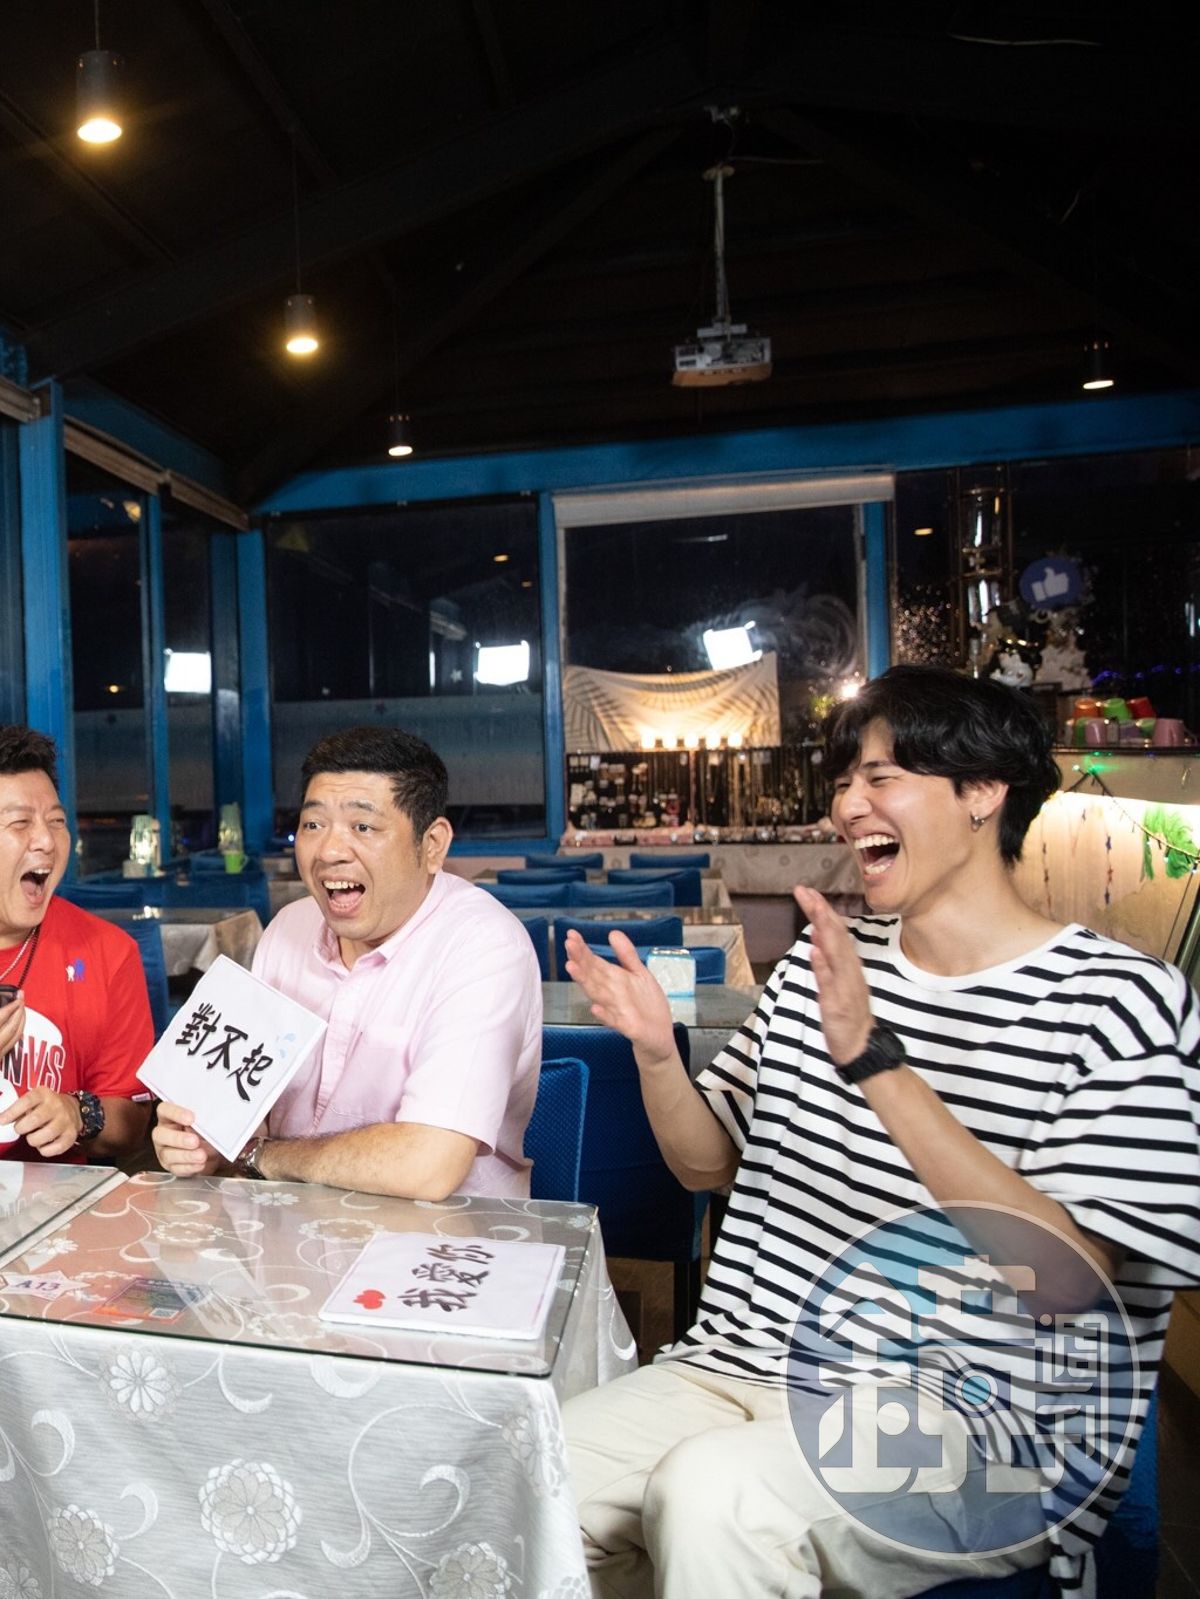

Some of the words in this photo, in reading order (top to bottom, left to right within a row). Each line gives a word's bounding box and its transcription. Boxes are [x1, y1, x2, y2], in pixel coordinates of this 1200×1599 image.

[175, 1002, 274, 1102] 對不起
[14, 1279, 62, 1292] A13
[397, 1243, 496, 1313] 我愛你
